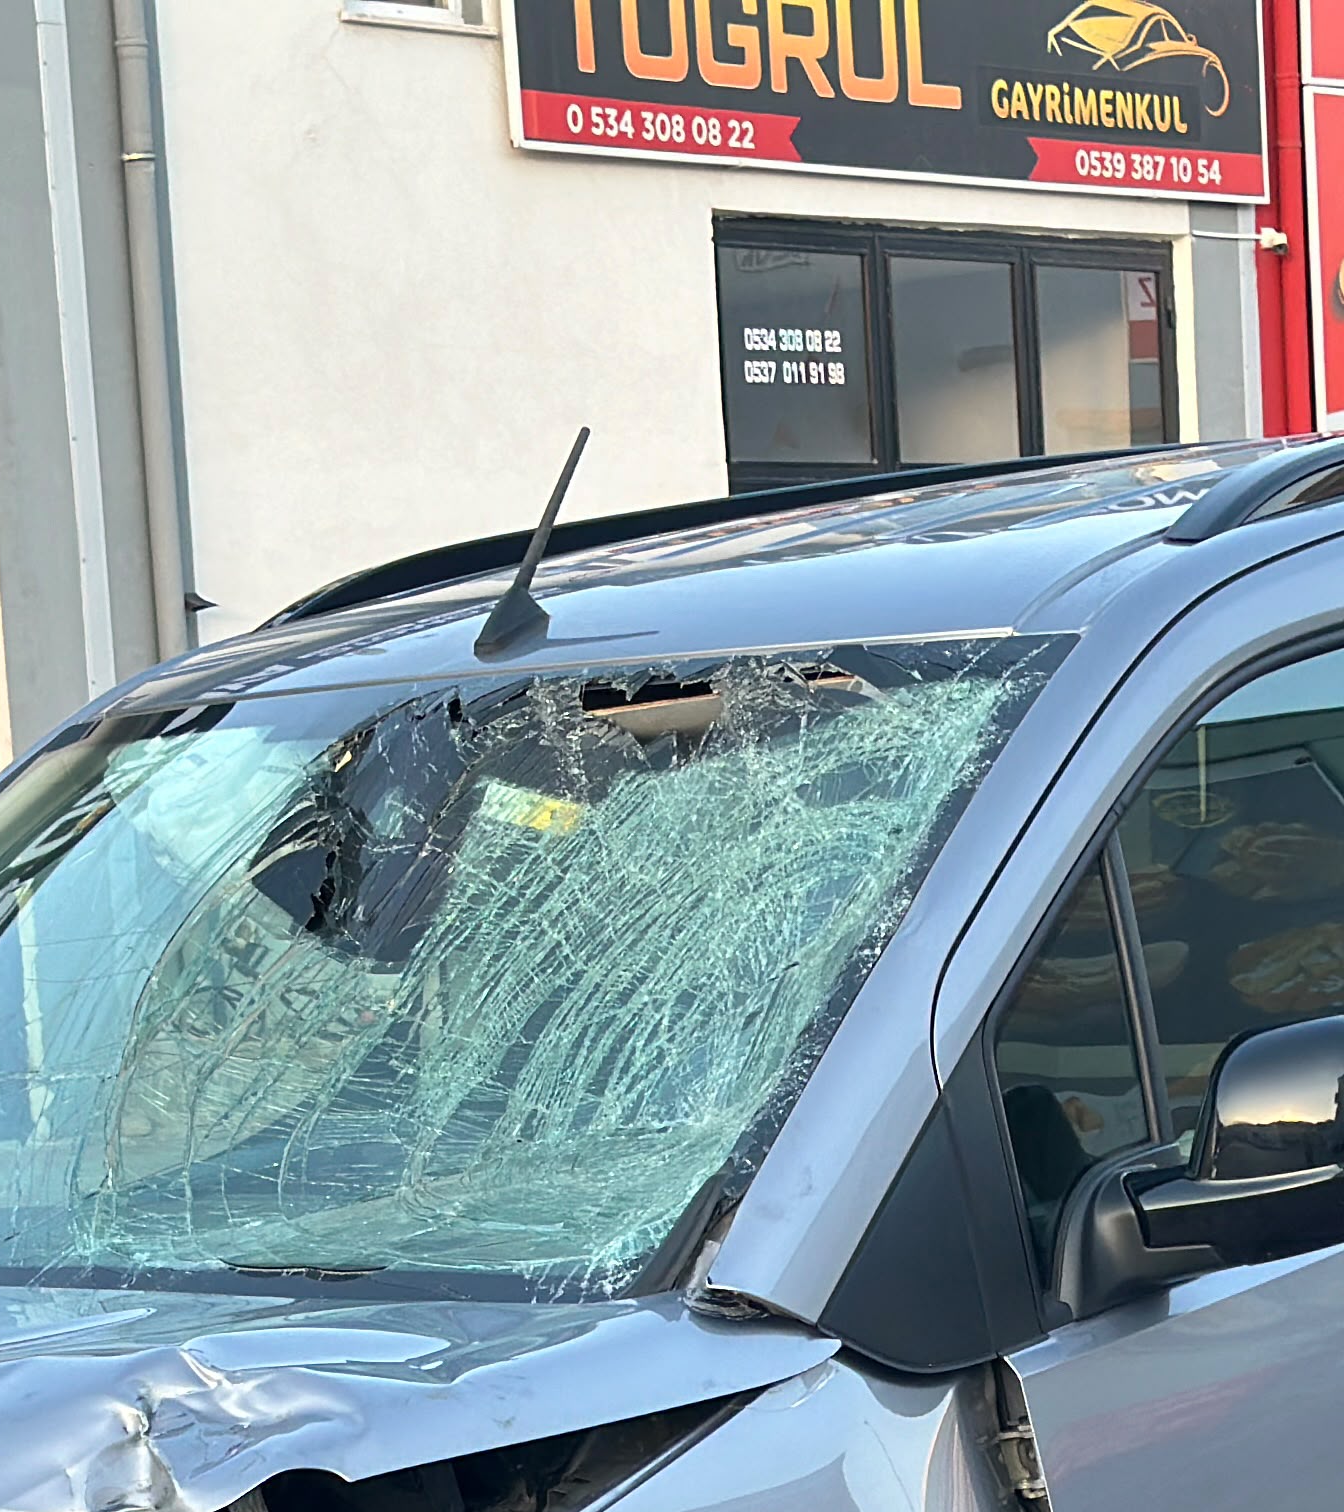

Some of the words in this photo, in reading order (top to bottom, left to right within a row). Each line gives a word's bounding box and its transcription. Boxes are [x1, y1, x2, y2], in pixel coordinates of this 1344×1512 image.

[566, 103, 584, 134] 0
[590, 106, 635, 139] 534
[641, 110, 686, 143] 308
[691, 116, 722, 147] 08
[727, 119, 755, 149] 22
[1075, 149, 1126, 179] 0539
[1130, 153, 1166, 182] 387
[1170, 156, 1192, 183] 10
[1197, 159, 1222, 185] 54
[824, 330, 842, 353] 22
[782, 360, 807, 384] 011
[809, 362, 825, 385] 91
